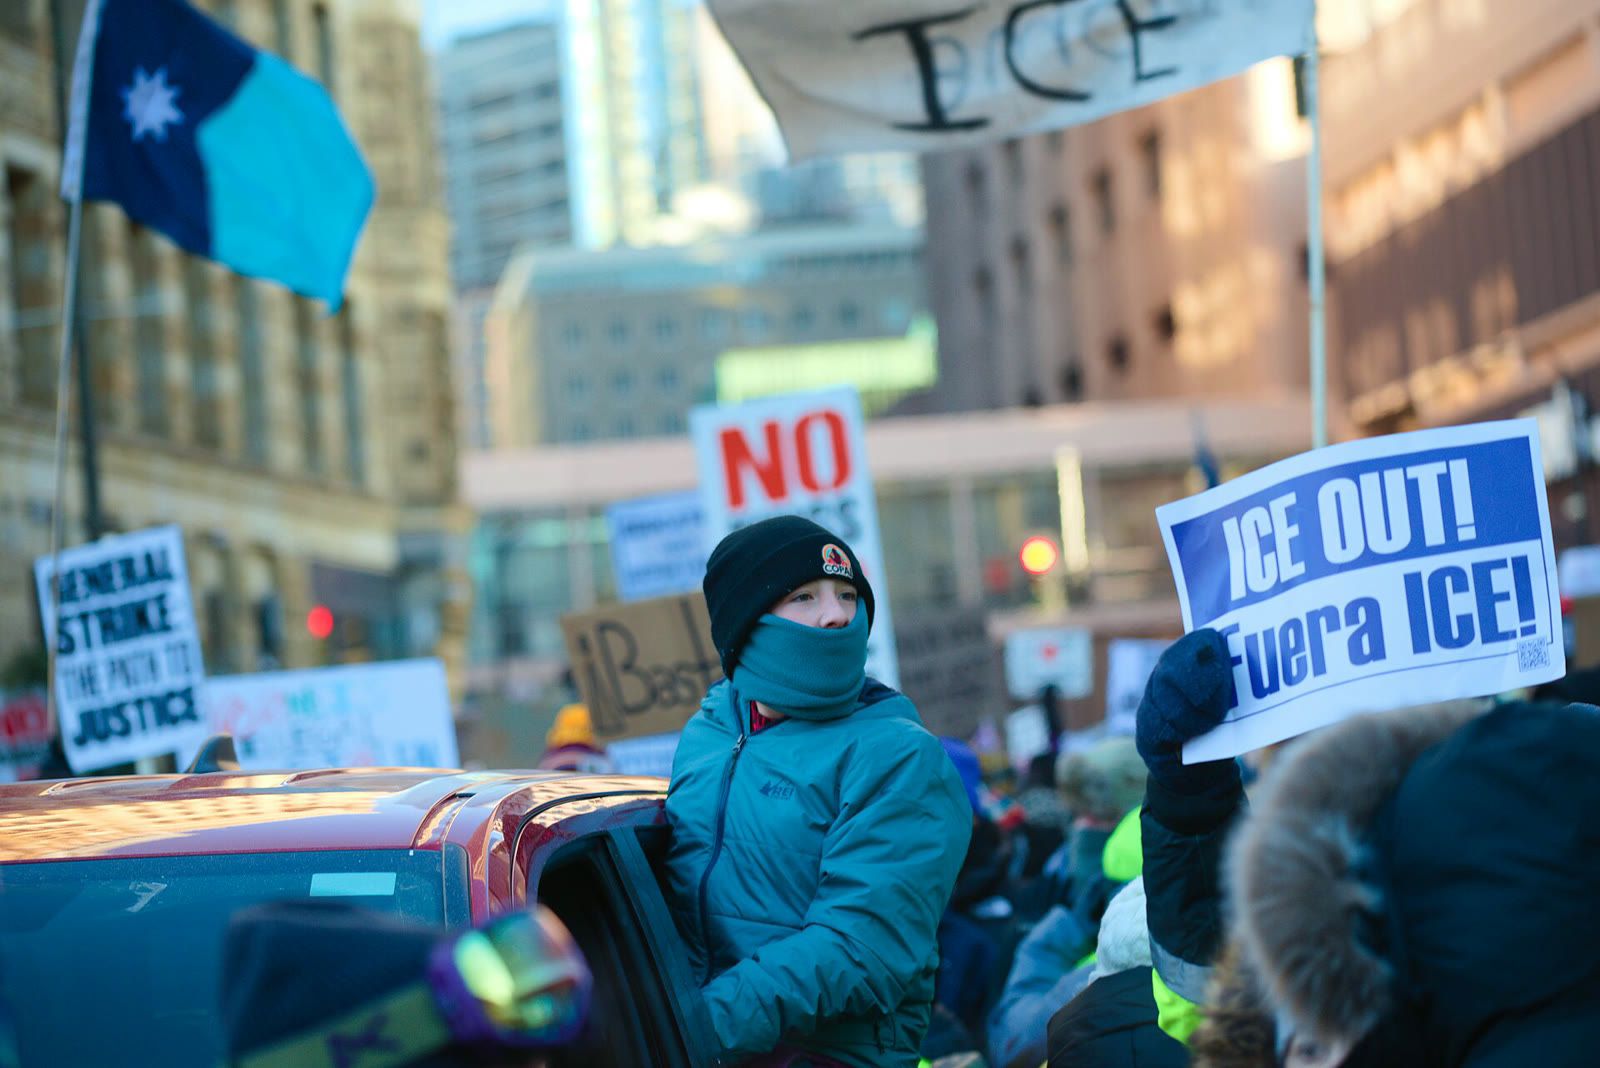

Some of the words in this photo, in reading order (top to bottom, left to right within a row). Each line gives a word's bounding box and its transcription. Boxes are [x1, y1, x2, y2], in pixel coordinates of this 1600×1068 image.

[851, 0, 1178, 131] ICE
[719, 407, 852, 512] NO
[1222, 491, 1305, 601] ICE
[1317, 458, 1476, 564] OUT!
[56, 593, 173, 655] STRIKE
[1404, 555, 1537, 655] ICE!
[74, 686, 198, 747] JUSTICE
